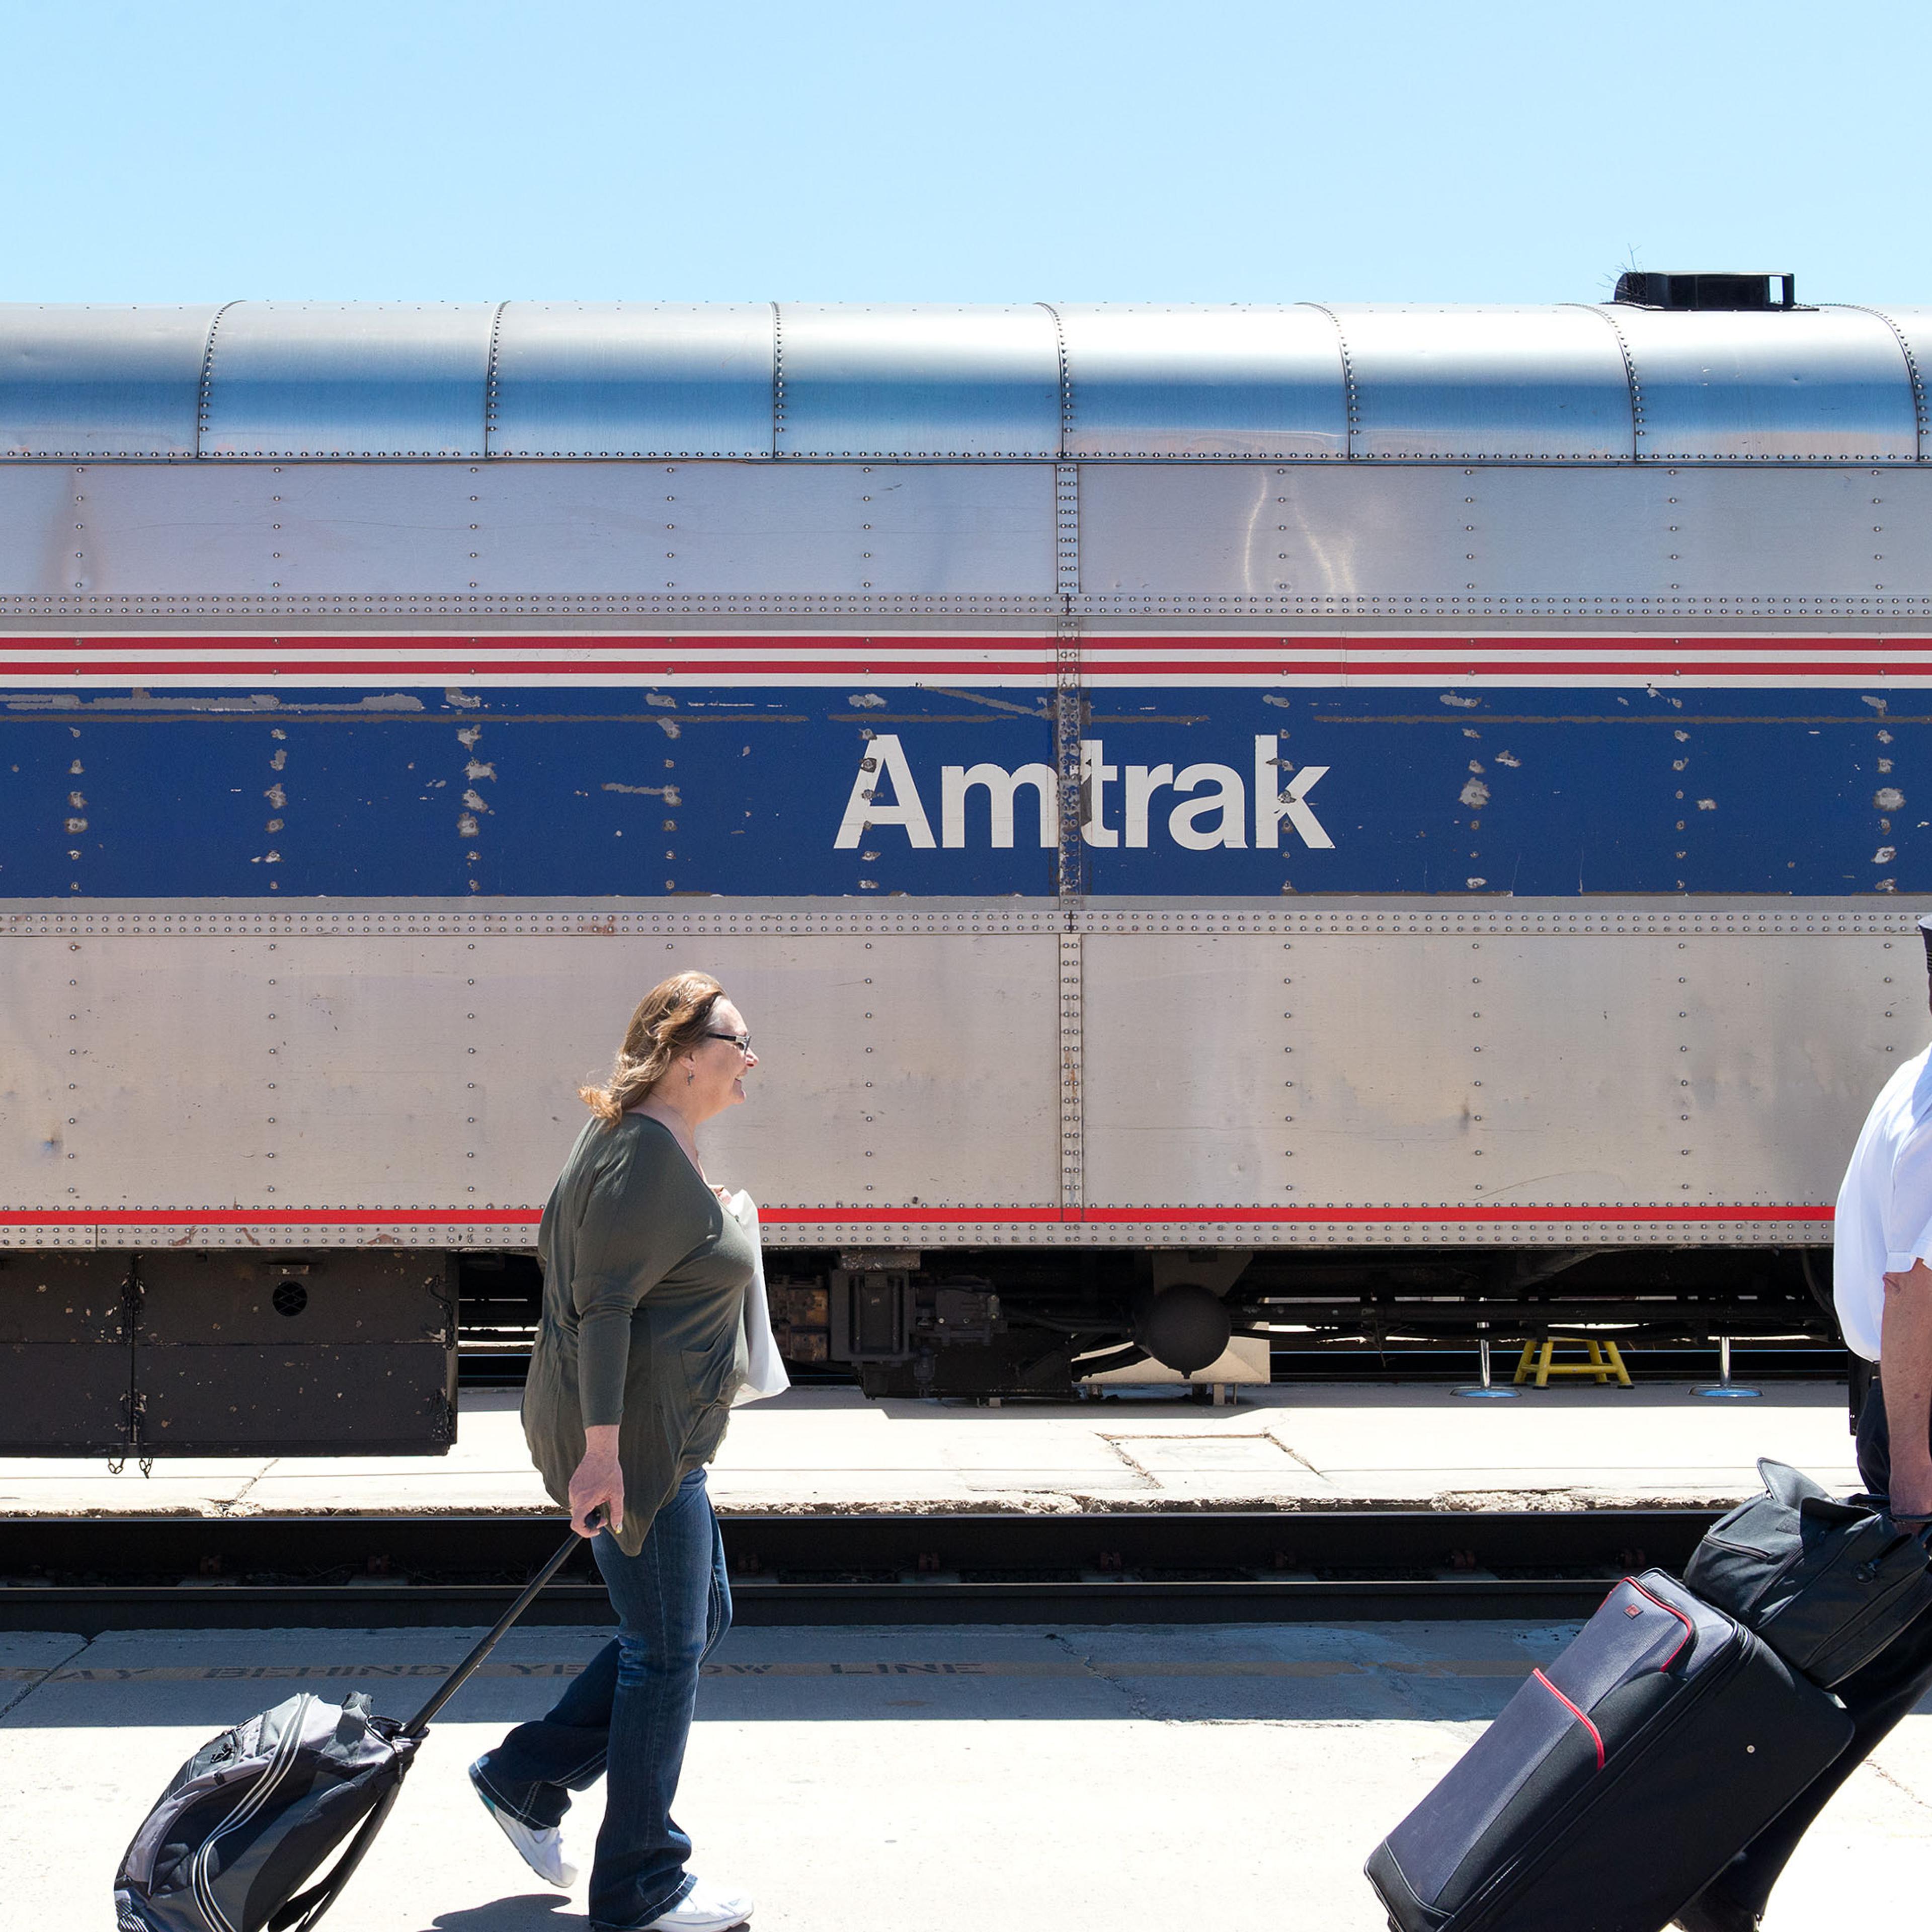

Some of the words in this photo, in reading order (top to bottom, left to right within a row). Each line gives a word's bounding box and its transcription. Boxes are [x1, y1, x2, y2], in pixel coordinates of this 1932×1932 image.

[833, 735, 1335, 850] Amtrak
[0, 1668, 153, 1680] TAY
[204, 1665, 450, 1678] BEHIND
[510, 1662, 773, 1675] YEOW
[831, 1664, 985, 1674] LINE
